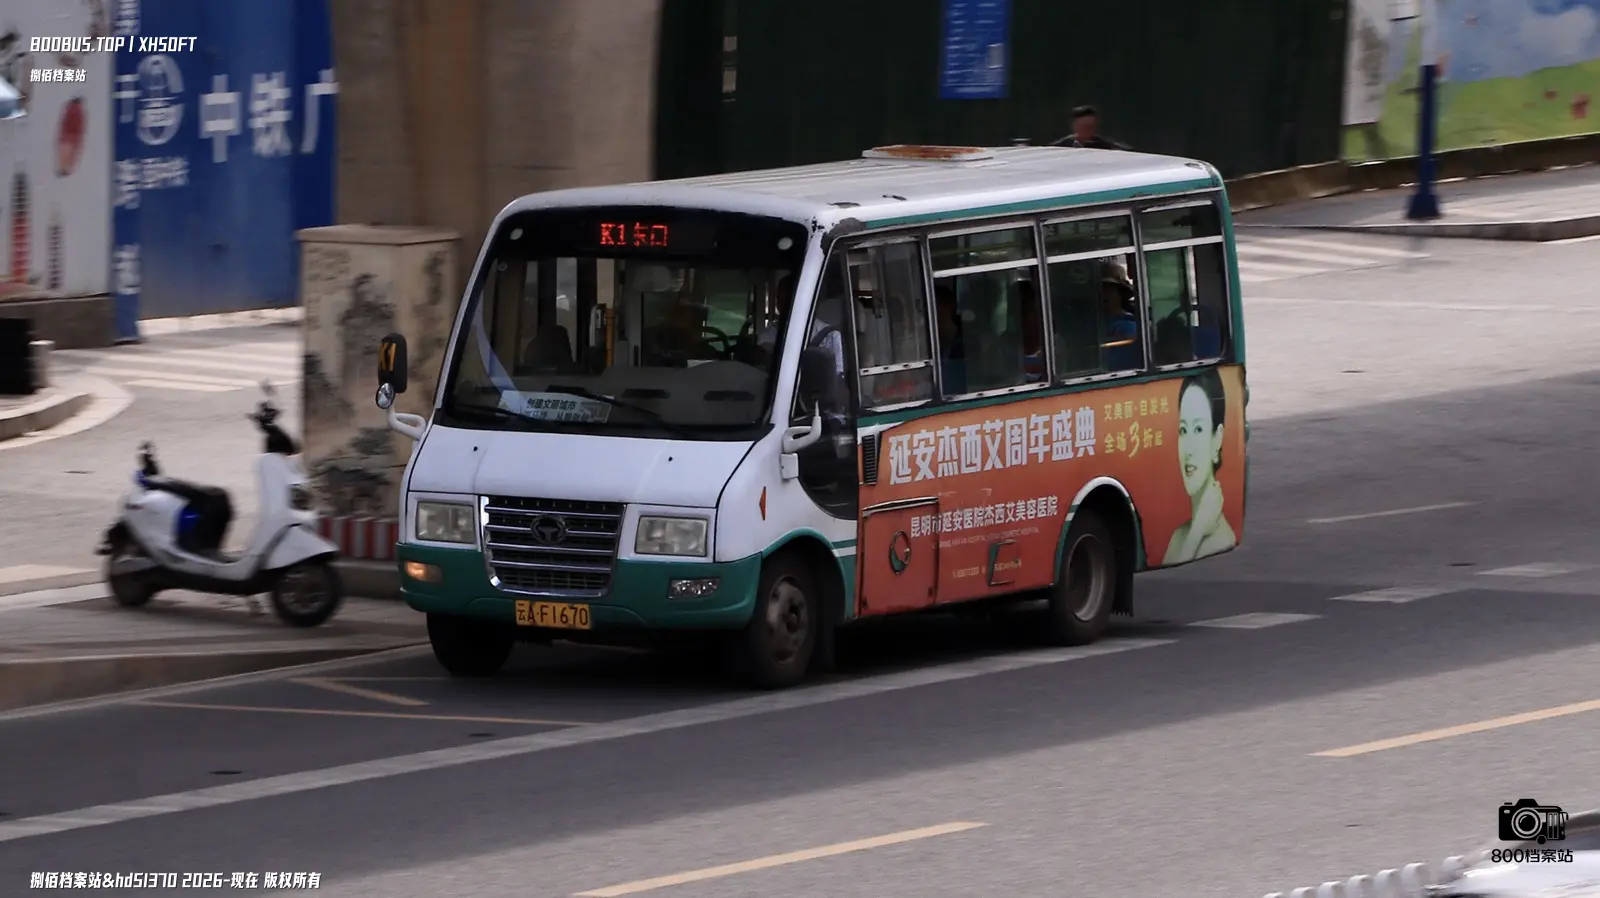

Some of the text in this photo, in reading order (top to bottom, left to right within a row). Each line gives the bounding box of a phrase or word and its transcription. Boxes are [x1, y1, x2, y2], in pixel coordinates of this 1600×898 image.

[889, 406, 1096, 486] 延安杰西艾周年盛典
[910, 495, 1058, 539] 昆明市延安医院杰西艾美容医院
